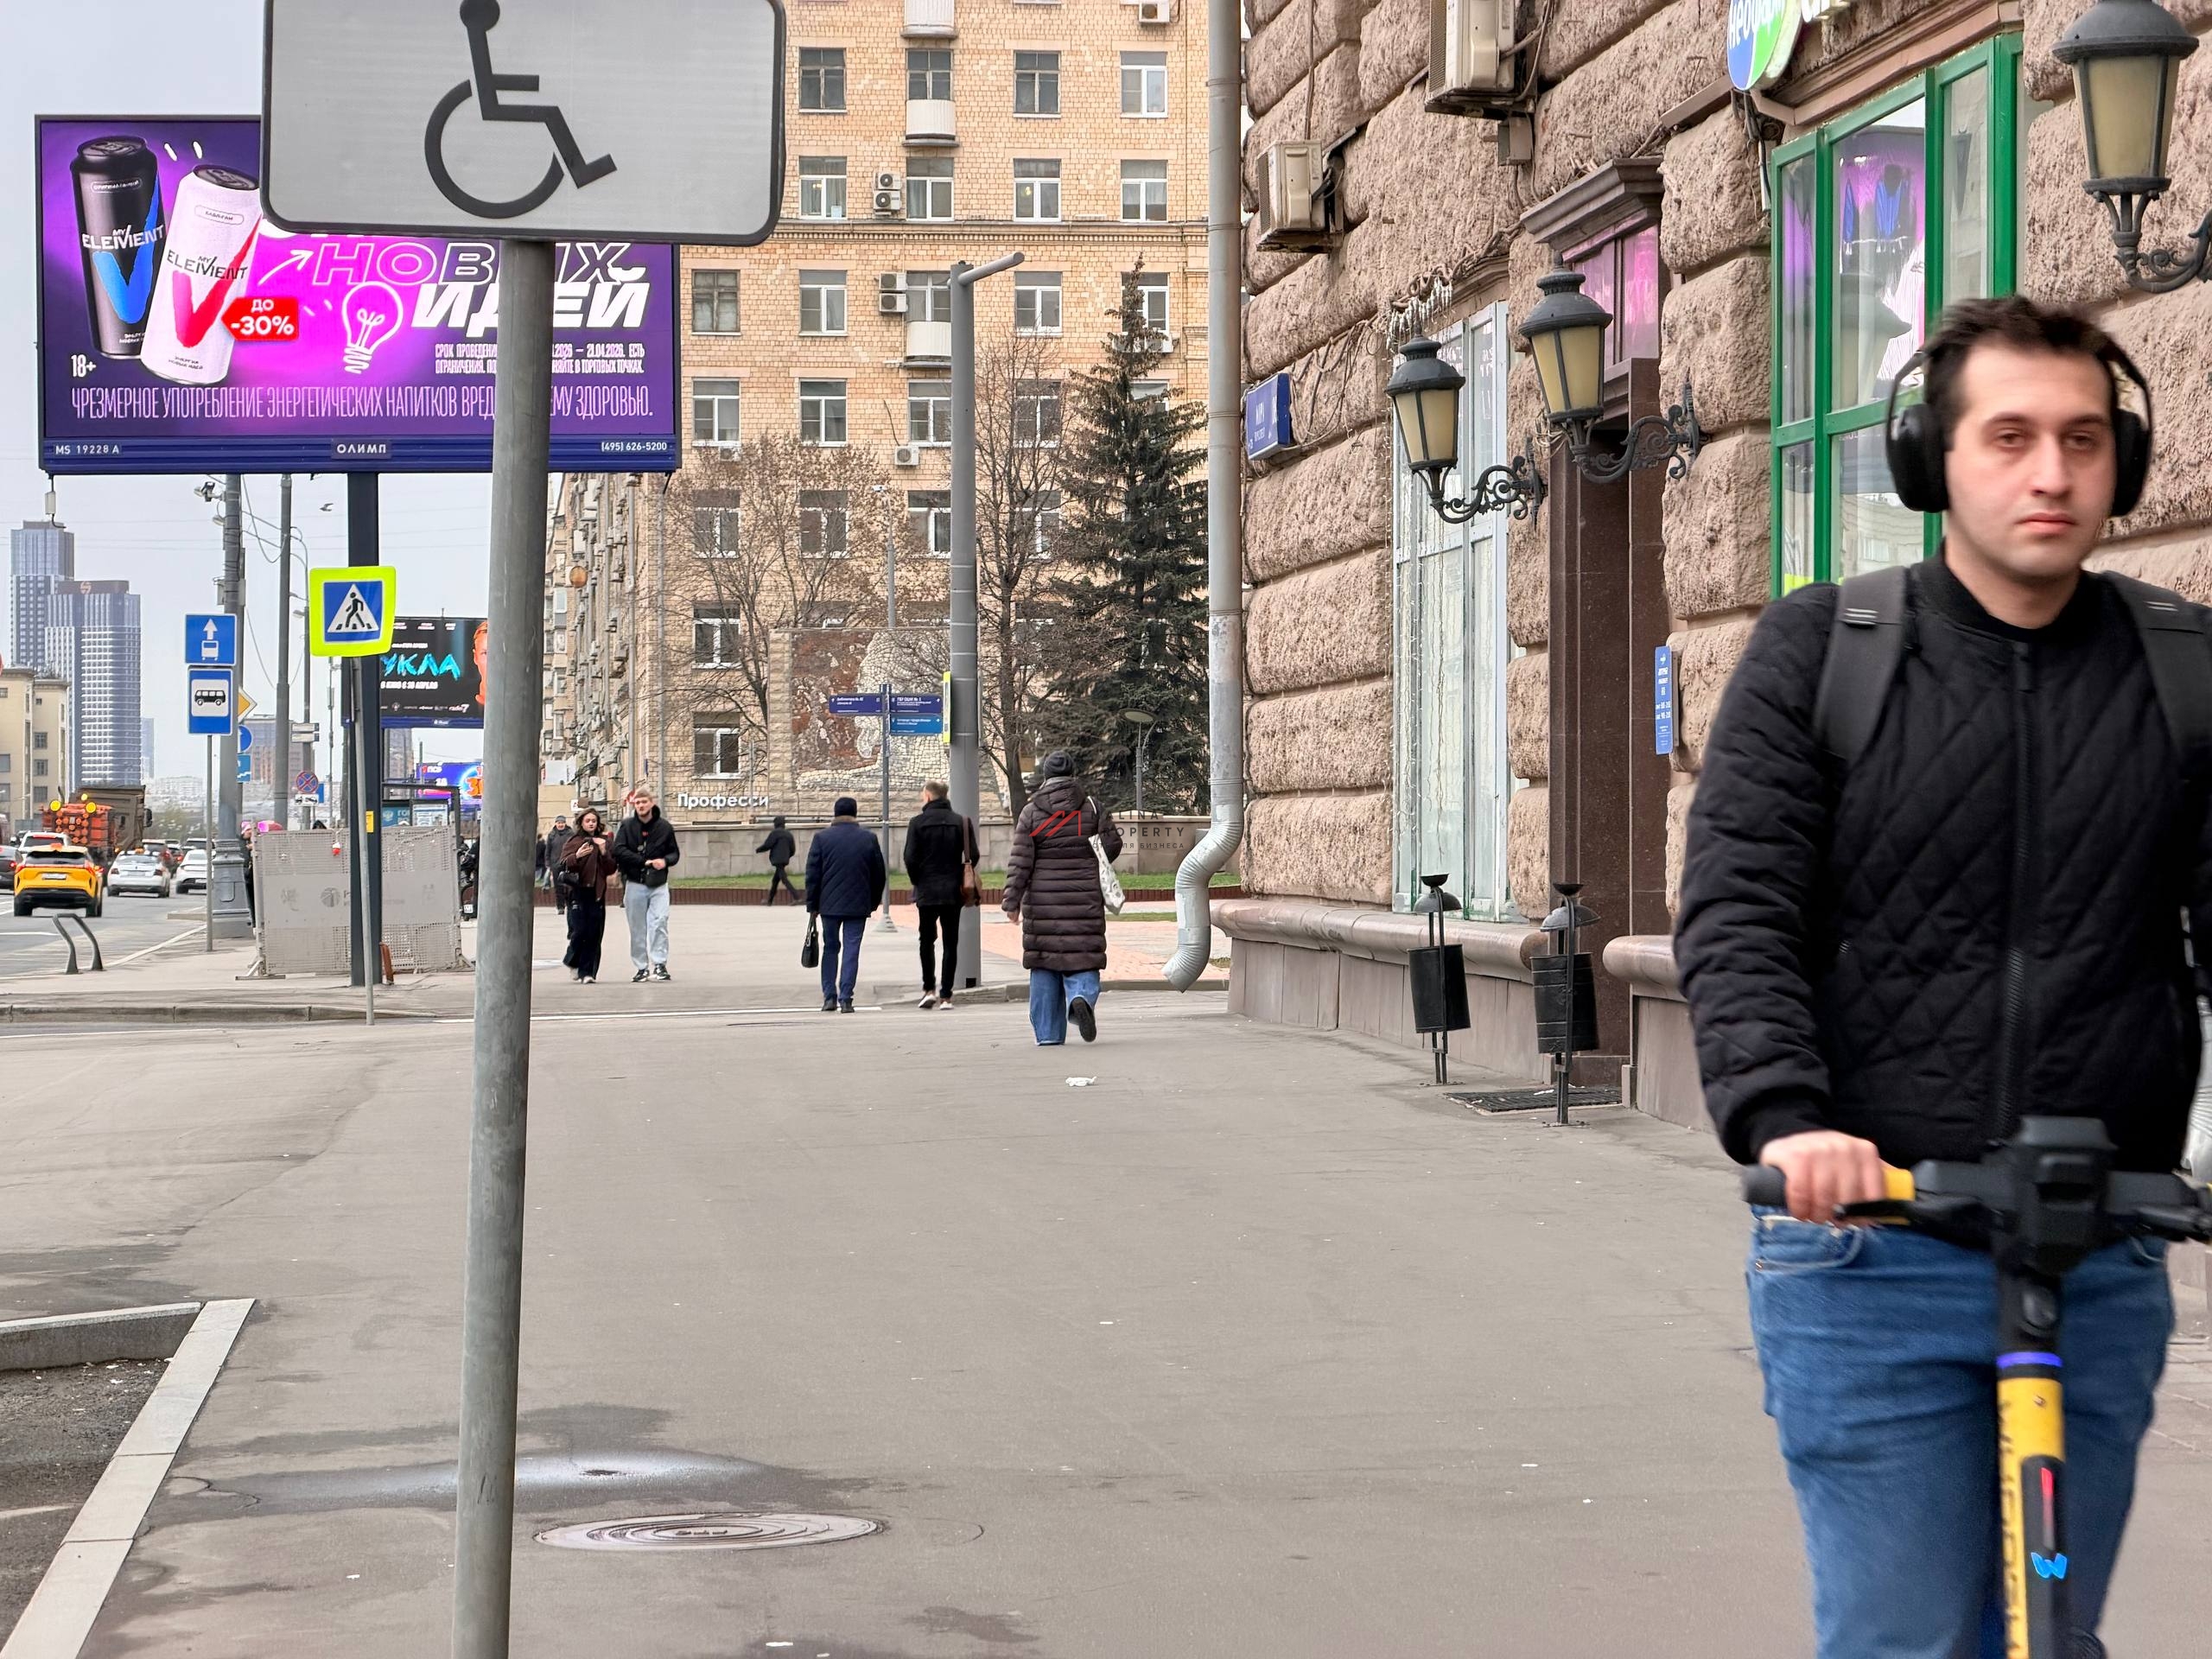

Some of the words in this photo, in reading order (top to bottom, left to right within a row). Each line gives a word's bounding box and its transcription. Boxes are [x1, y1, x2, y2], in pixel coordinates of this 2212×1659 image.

[82, 225, 164, 250] ELEMENT
[112, 228, 127, 237] MY
[167, 250, 248, 280] ELEMENT
[313, 242, 631, 286] НОВХ
[251, 299, 274, 312] ДО
[230, 315, 295, 335] -30%
[435, 344, 454, 358] СРОК
[456, 344, 497, 359] ПРОВЕДЕНИ
[629, 344, 645, 358] ЕСТЬ
[71, 354, 97, 378] 18+
[435, 359, 486, 373] ОГРАНИЧЕНИЯ.
[552, 357, 574, 373] НЯЙТЕ
[575, 359, 582, 373] В
[582, 359, 617, 373] ТОРГОВЫХ
[617, 359, 645, 373] ТОЧКАХ.
[72, 387, 160, 419] ЧРЕЗМЕРНОЕ
[162, 386, 264, 418] УПОТРЕБЛЕНИЕ
[267, 386, 383, 418] ЭНЕРГЕТИЧЕСКИХ
[386, 385, 457, 417] НАПИТКОВ
[461, 385, 496, 421] ВРЕД
[575, 385, 654, 421] ЗДОРОВЬЮ.
[55, 445, 71, 455] MS
[76, 445, 109, 454] 19228
[111, 445, 120, 454] A
[336, 444, 387, 454] ОЛИМП
[601, 442, 624, 452] (495)
[626, 442, 668, 451] 626-5200
[380, 653, 461, 681] УКЛА
